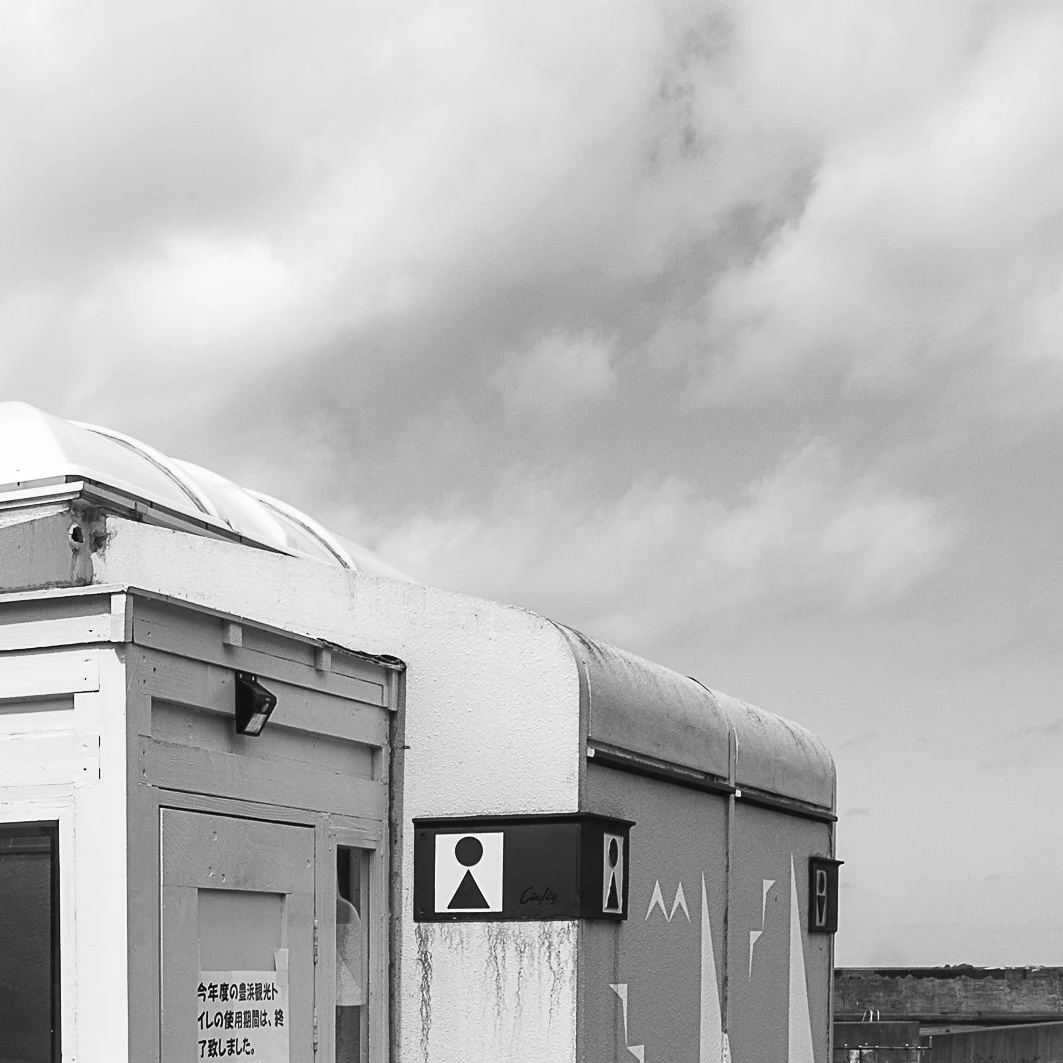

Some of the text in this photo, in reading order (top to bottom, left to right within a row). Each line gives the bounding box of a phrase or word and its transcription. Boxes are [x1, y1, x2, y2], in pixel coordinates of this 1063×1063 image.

[197, 982, 279, 1002] 今年度の豊浜観光ト
[197, 1009, 284, 1030] イレの使用期間は、終
[198, 1038, 255, 1058] 了致しました。
